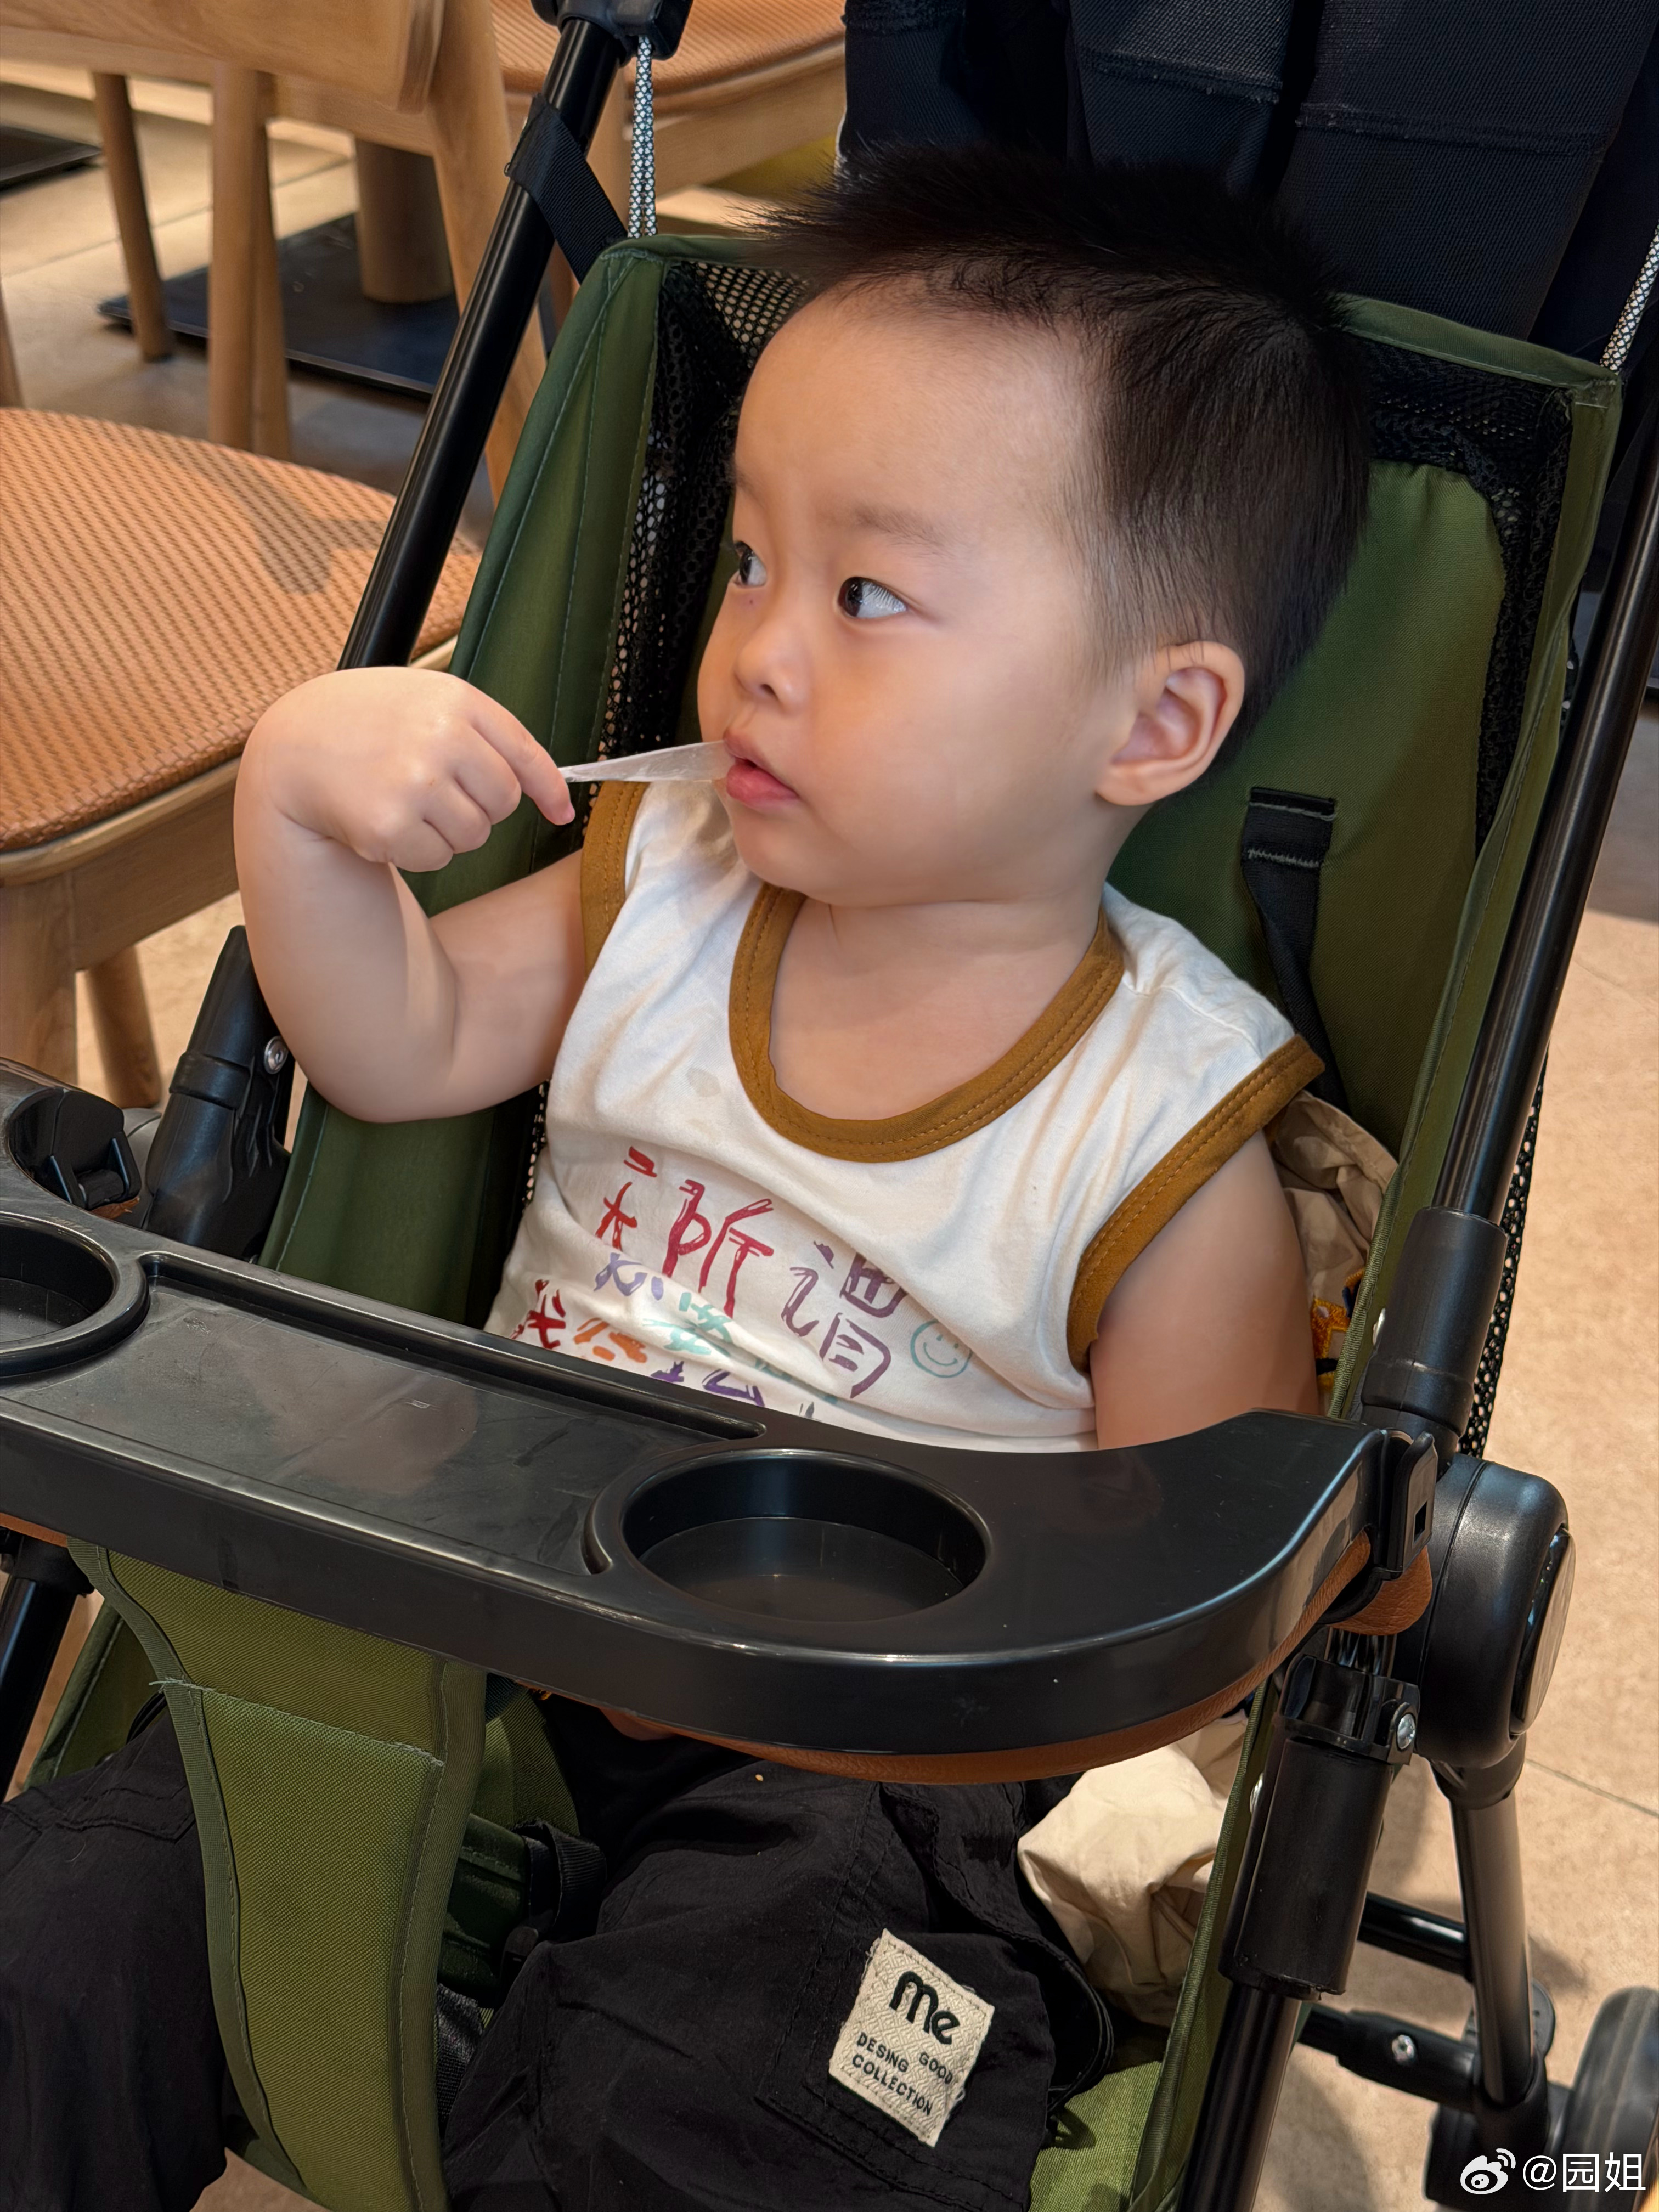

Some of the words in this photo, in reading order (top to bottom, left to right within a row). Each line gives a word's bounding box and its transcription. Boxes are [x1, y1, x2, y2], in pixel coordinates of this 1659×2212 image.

[851, 2053, 934, 2116] COLLECTION
[856, 2032, 909, 2072] DESING
[918, 2051, 953, 2085] GOOD
